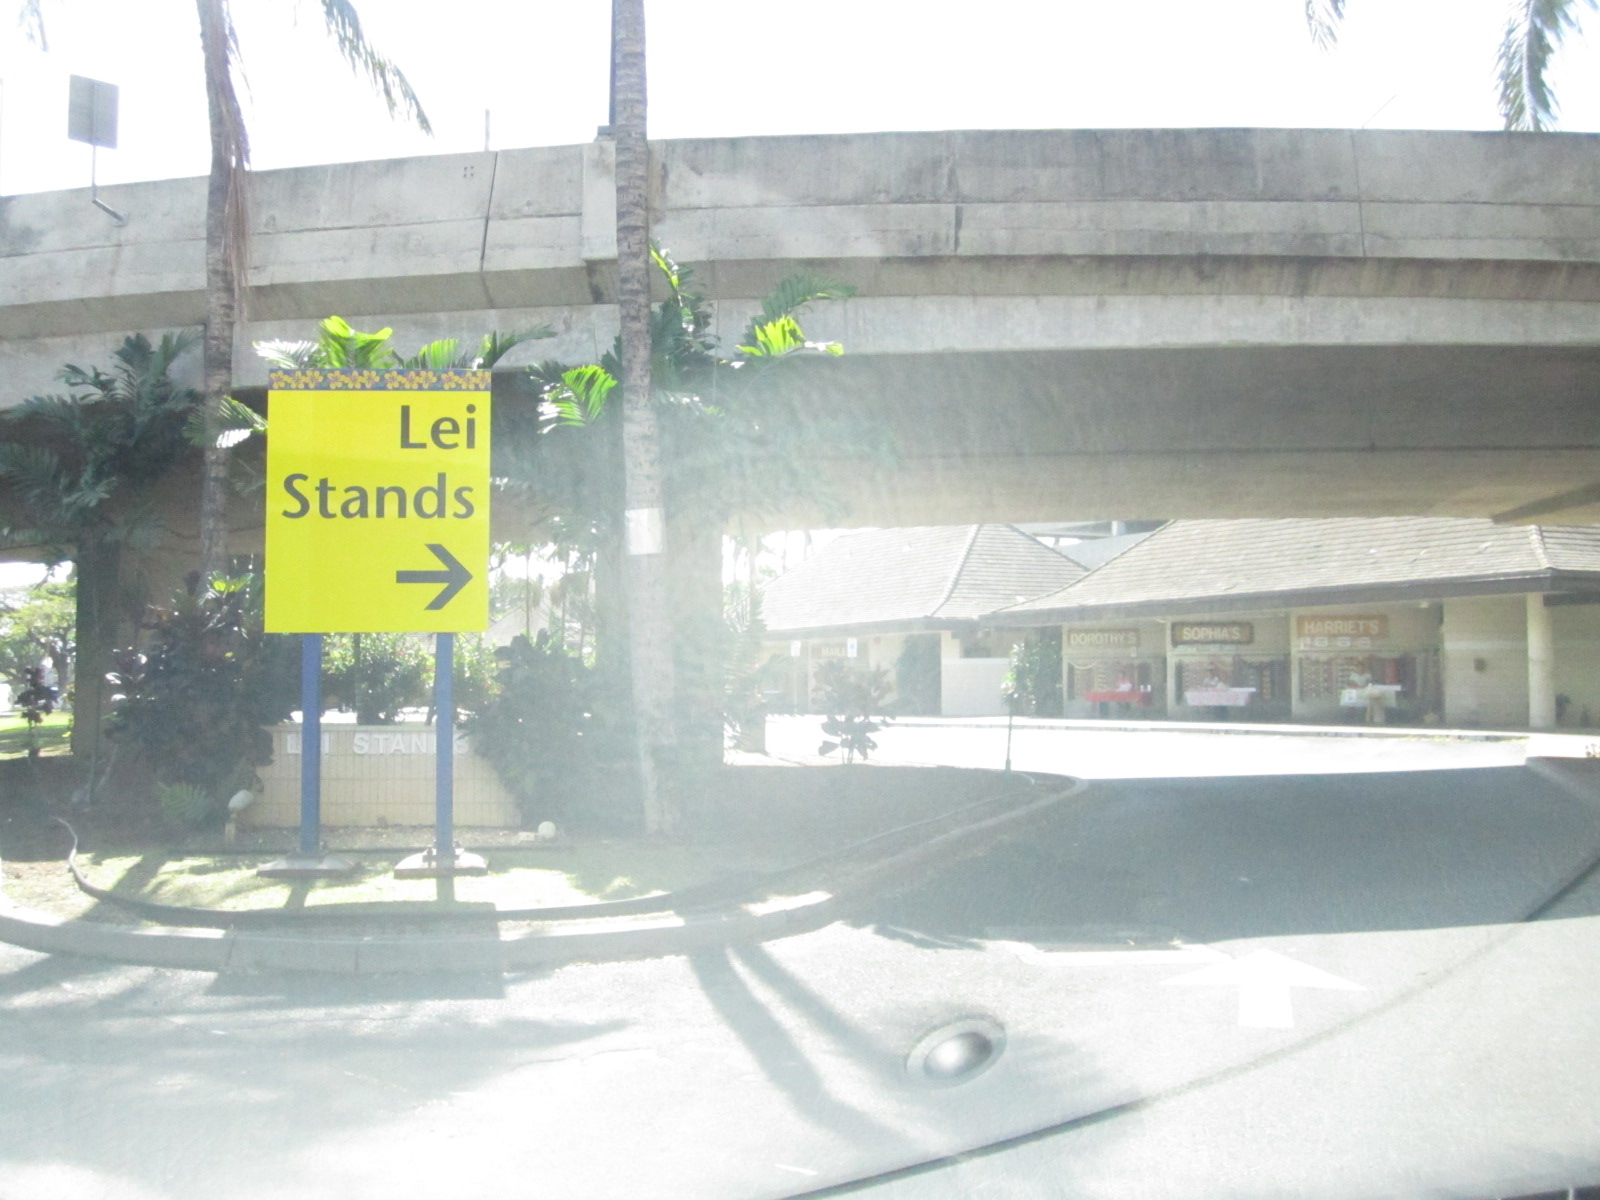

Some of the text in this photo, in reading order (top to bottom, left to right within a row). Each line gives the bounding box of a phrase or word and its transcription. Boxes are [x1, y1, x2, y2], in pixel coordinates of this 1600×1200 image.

[400, 403, 477, 450] Lei
[281, 472, 475, 519] Stands
[1182, 626, 1241, 641] SOPHIA'S
[1304, 619, 1379, 635] HARRIET'S
[1070, 632, 1136, 646] DOROTHY'S
[286, 733, 330, 754] LI
